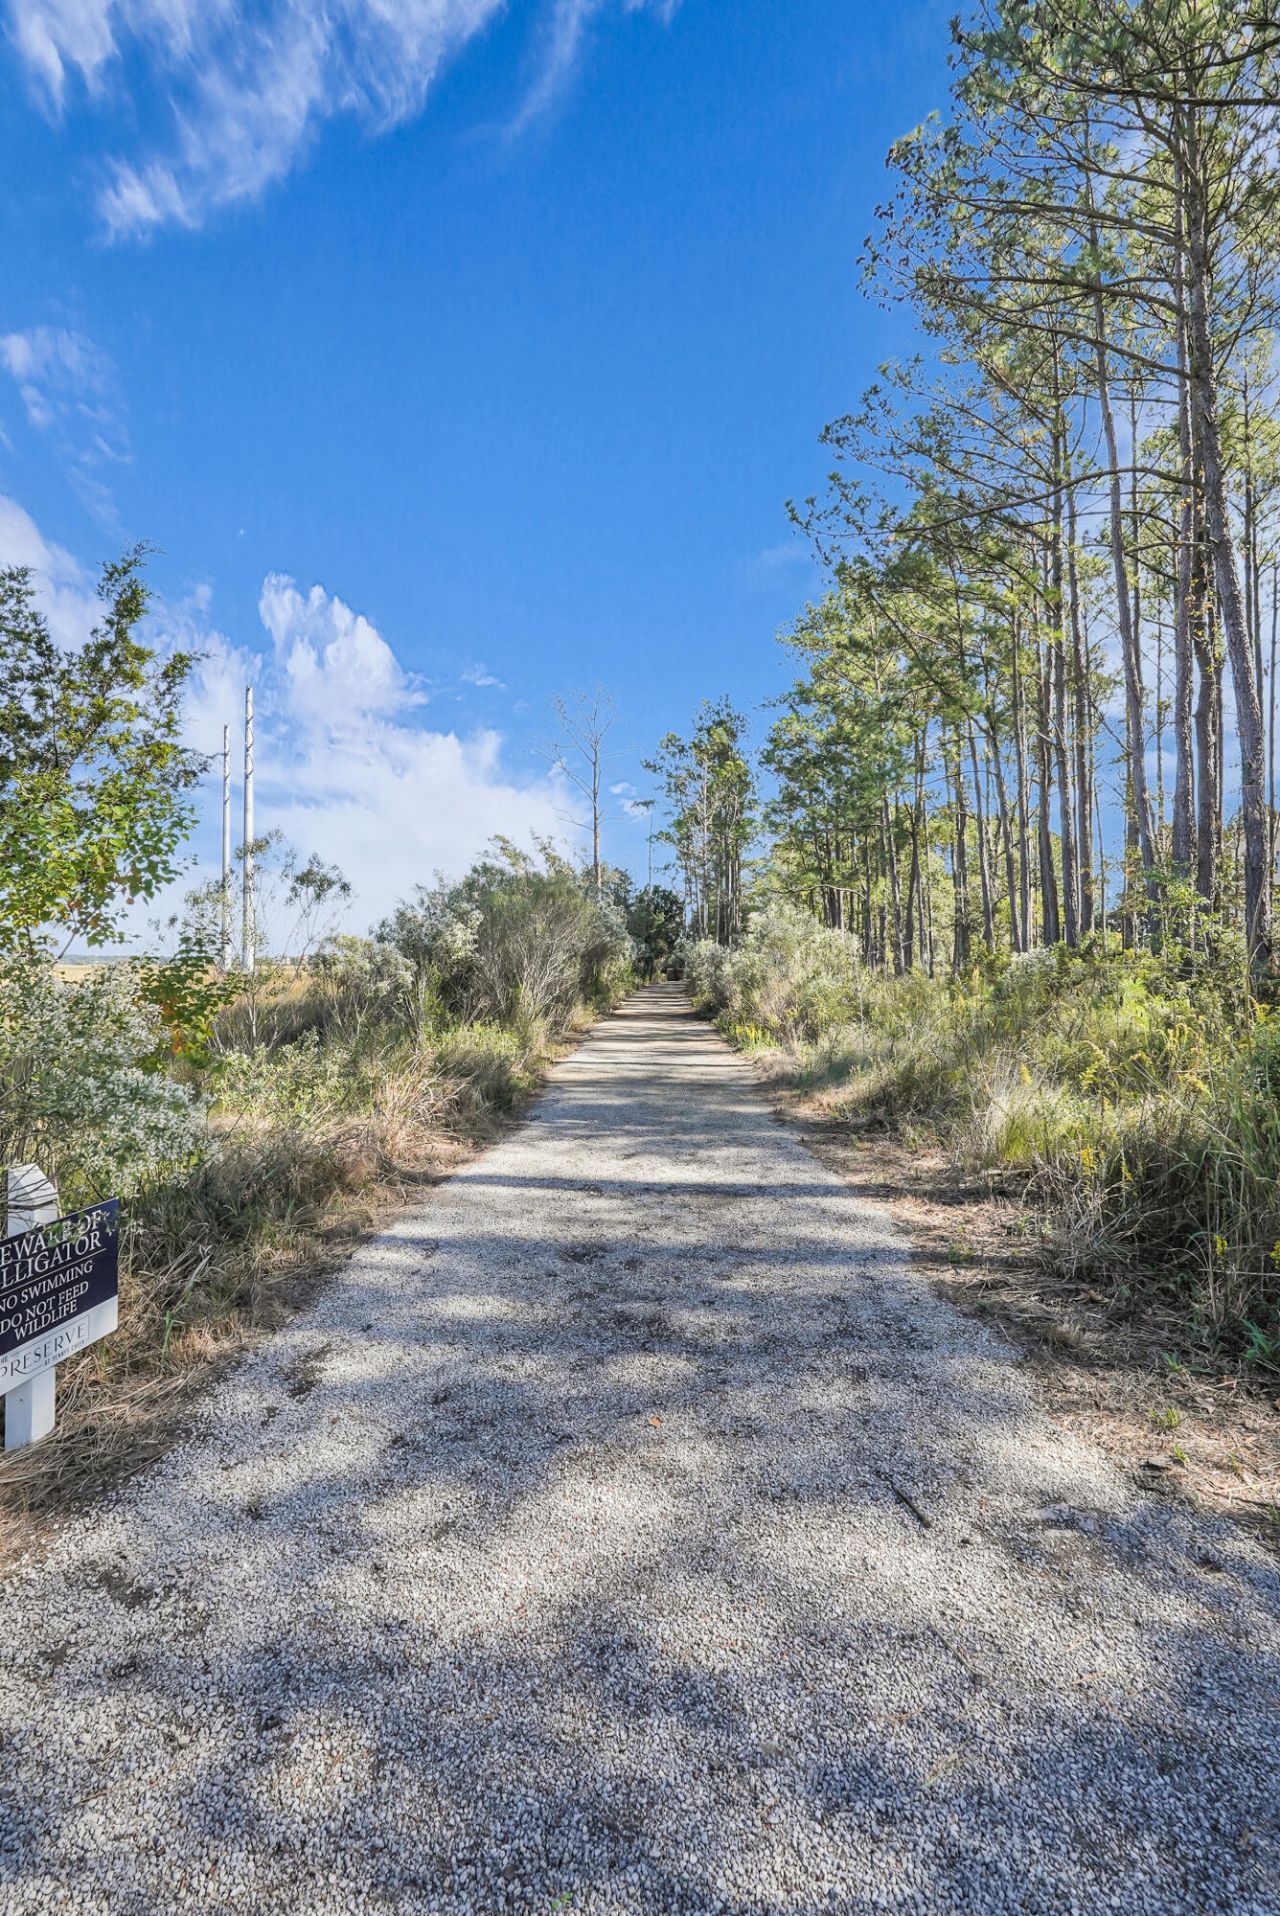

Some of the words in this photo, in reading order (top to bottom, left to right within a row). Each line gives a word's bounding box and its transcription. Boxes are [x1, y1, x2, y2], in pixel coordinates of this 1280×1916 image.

[1, 1231, 102, 1289] LLIGATOR
[20, 1260, 94, 1304] SWIMMING
[0, 1313, 23, 1336] DO
[26, 1296, 55, 1321] NOT
[58, 1281, 89, 1306] FEED
[14, 1299, 78, 1340] WILDLIFE
[0, 1355, 8, 1364] HE
